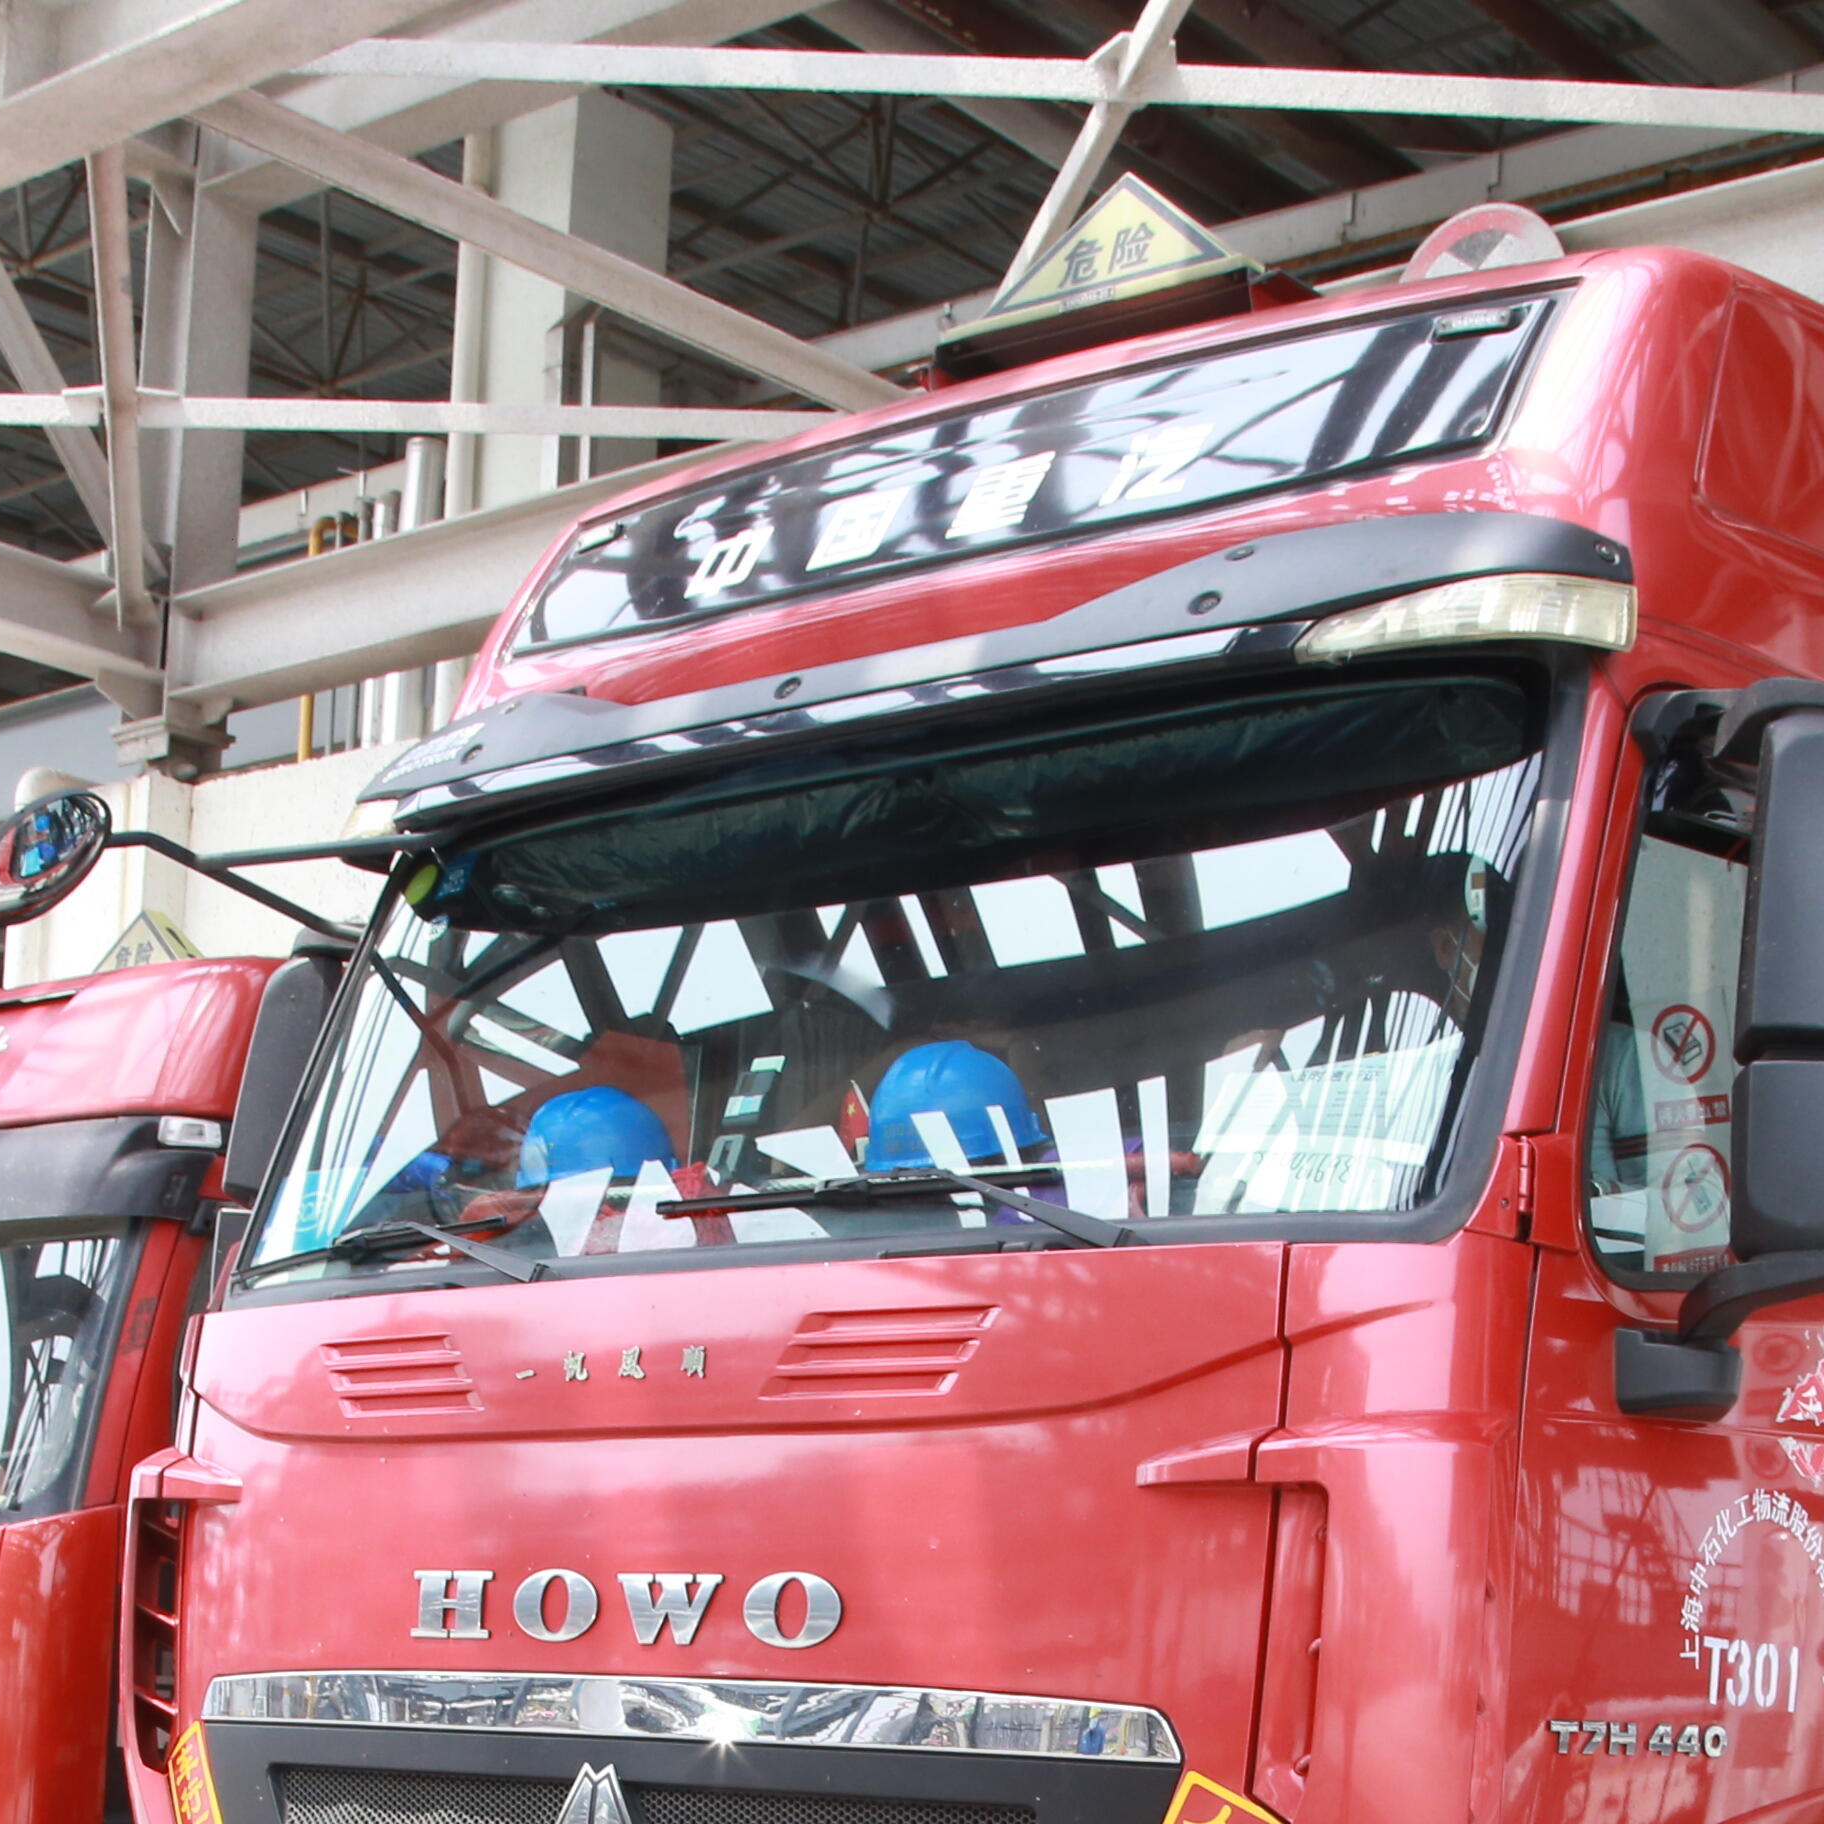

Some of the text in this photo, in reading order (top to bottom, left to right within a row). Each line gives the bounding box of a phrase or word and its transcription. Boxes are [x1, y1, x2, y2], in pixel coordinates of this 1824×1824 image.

[1058, 221, 1155, 289] 危险
[684, 423, 1213, 600] 中国重汽
[410, 1568, 843, 1649] HOWO
[1703, 1635, 1800, 1713] T301
[1550, 1719, 1728, 1758] T7H 440
